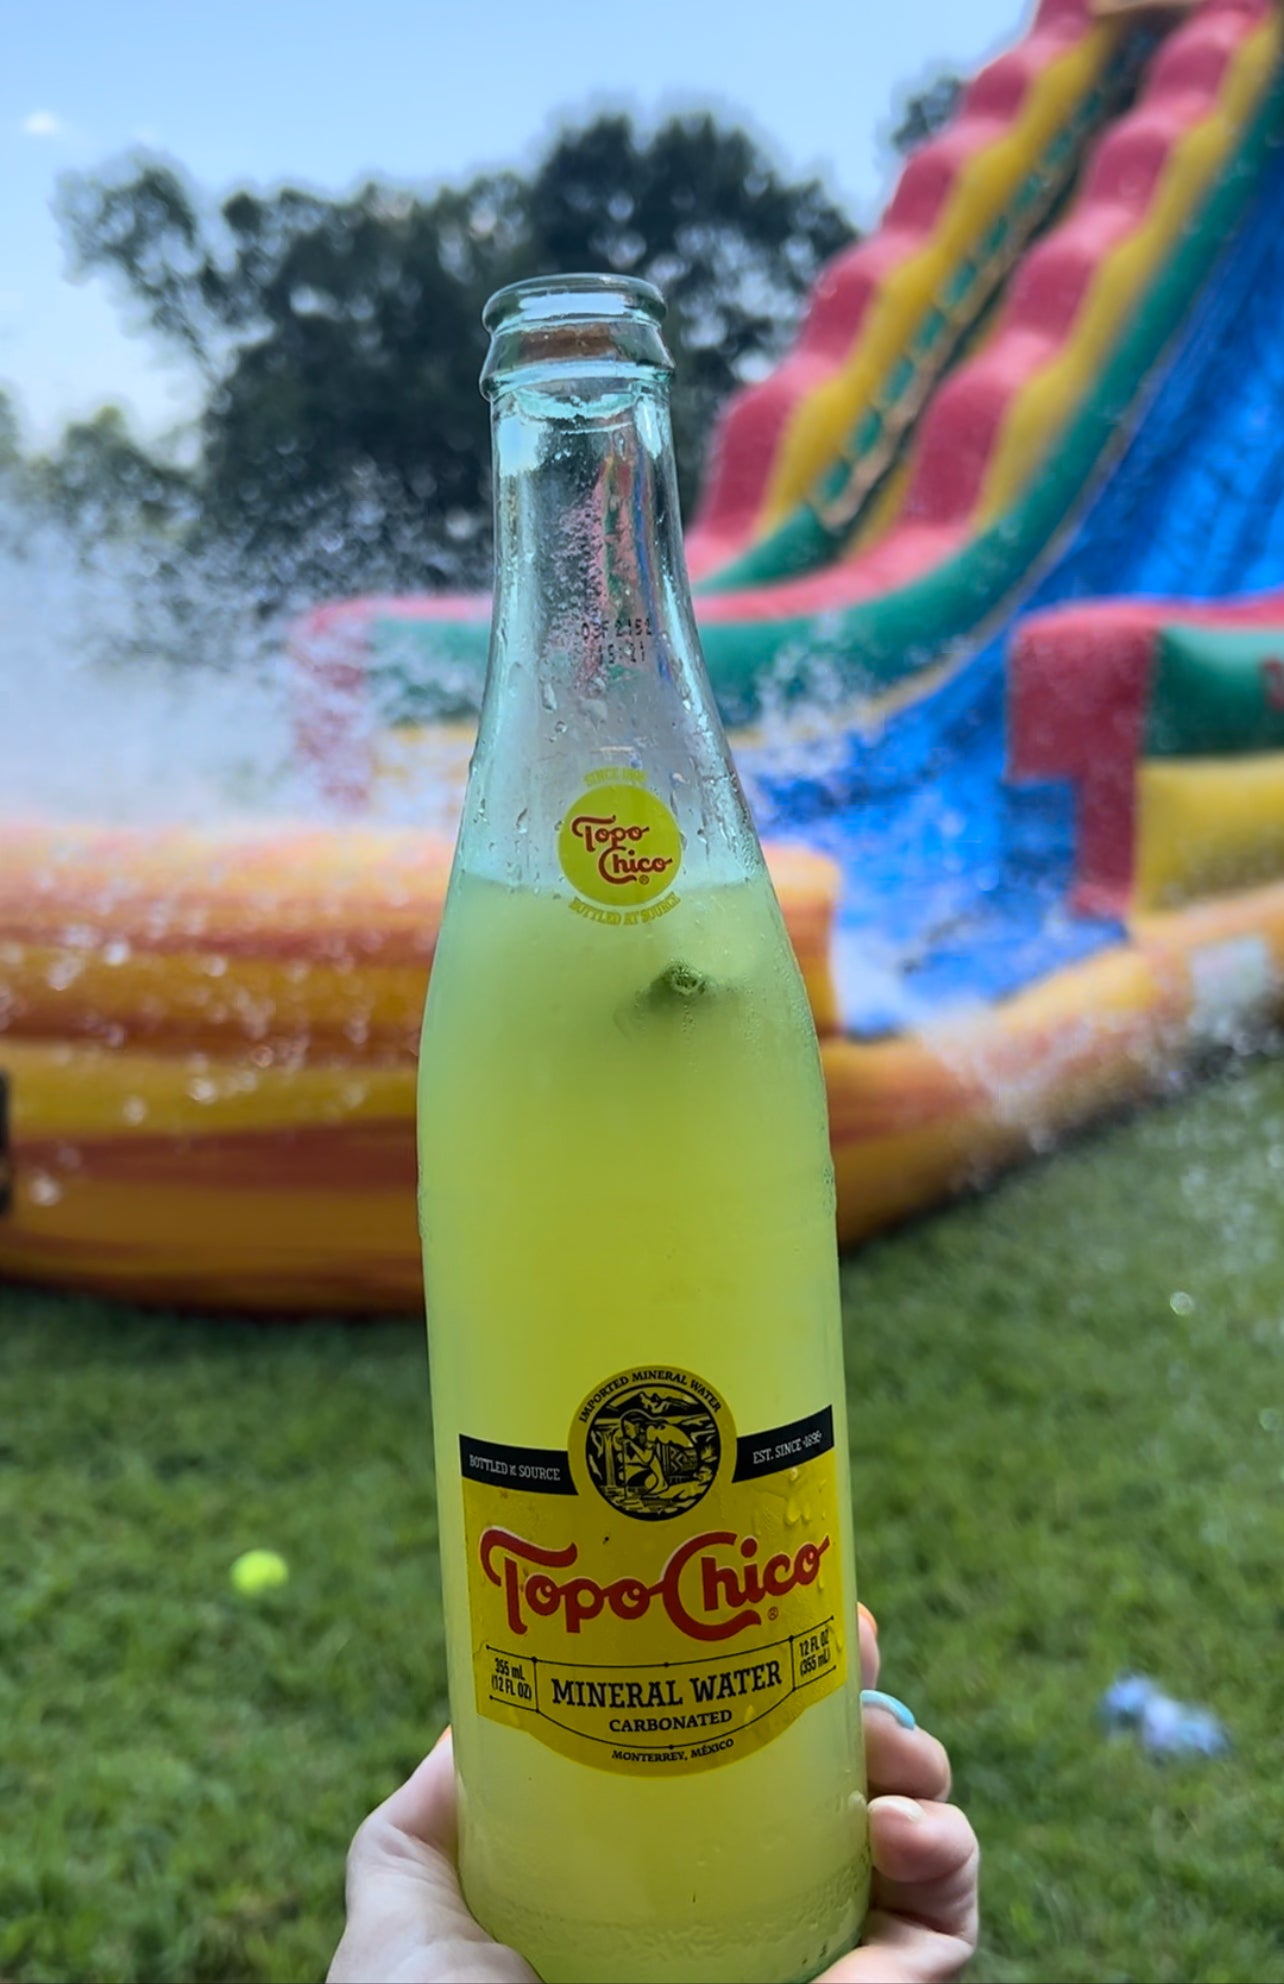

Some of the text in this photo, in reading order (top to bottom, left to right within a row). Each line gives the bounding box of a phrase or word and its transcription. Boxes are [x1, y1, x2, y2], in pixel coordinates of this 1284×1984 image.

[572, 815, 650, 853] Topo
[598, 846, 673, 885] Chico
[568, 896, 622, 926] BOTTLED
[624, 911, 641, 926] AT
[578, 1369, 722, 1423] IMPORTED MINERAL WATER
[753, 1447, 774, 1465] EST.
[775, 1437, 802, 1458] SINCE
[469, 1454, 508, 1475] BOTTLED
[518, 1464, 561, 1481] SOURCE
[480, 1525, 831, 1642] Topo Chico
[799, 1639, 809, 1658] 12
[810, 1635, 820, 1653] FL
[495, 1657, 510, 1676] 355
[800, 1654, 817, 1678] (355
[491, 1674, 532, 1701] (12 FL OZ)
[551, 1660, 782, 1709] MINERAL WATER
[608, 1708, 733, 1733] CARBONATED
[611, 1737, 735, 1763] MONTERREY, MÉXICO
